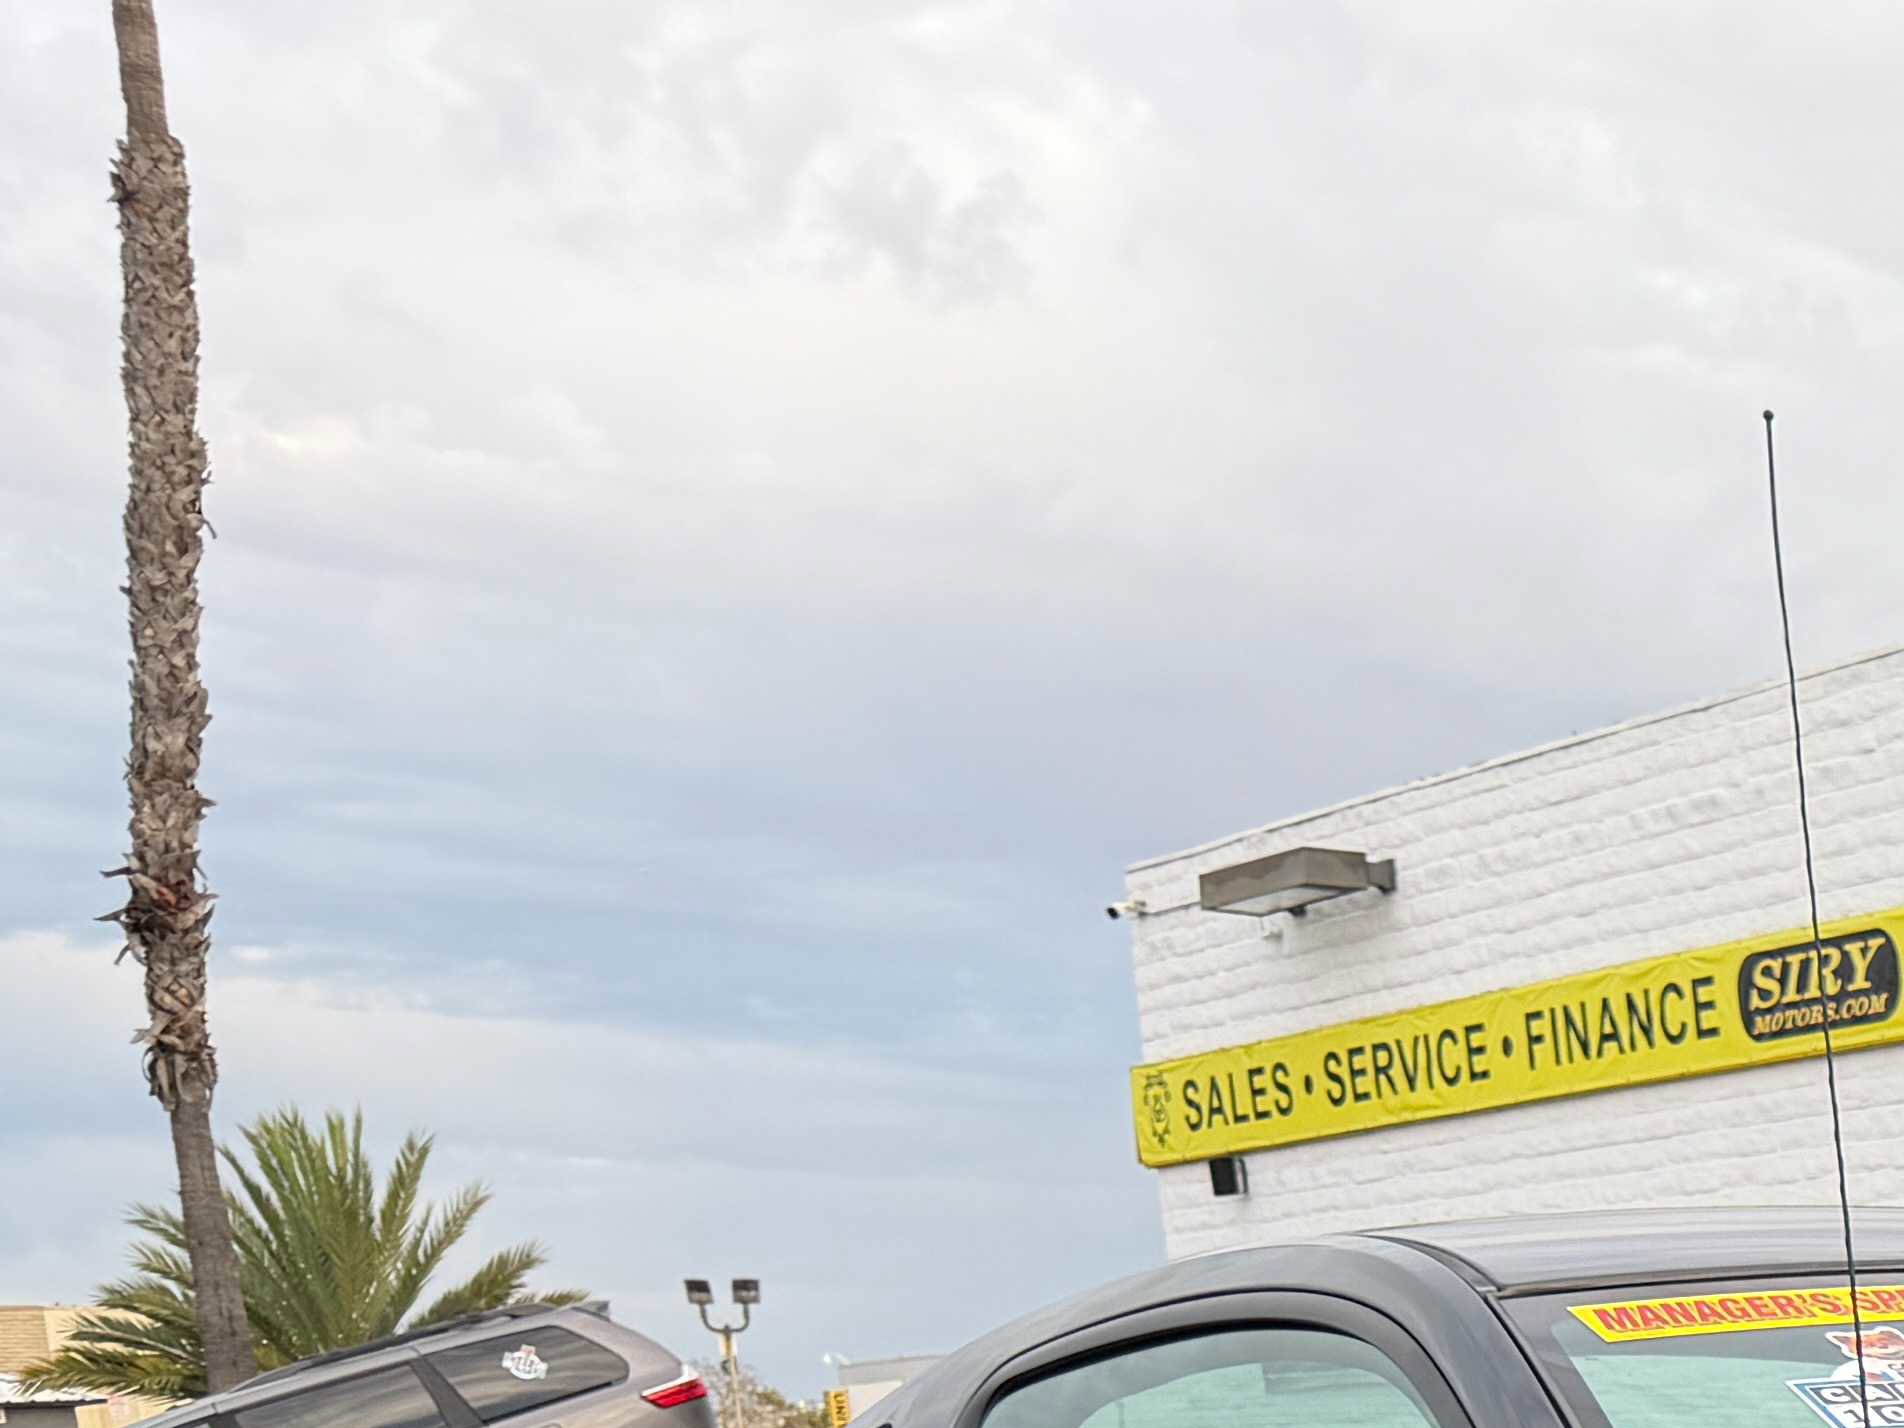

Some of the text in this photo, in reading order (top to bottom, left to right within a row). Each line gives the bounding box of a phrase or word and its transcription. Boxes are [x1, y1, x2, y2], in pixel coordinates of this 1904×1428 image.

[1747, 937, 1886, 1011] SIRY
[1751, 991, 1891, 1037] MOTORS.COM
[1181, 1061, 1295, 1132] SALES
[1325, 1022, 1492, 1108] SERVICE
[1525, 975, 1721, 1073] FINANCE
[1592, 1292, 1842, 1333] MANAGER'S
